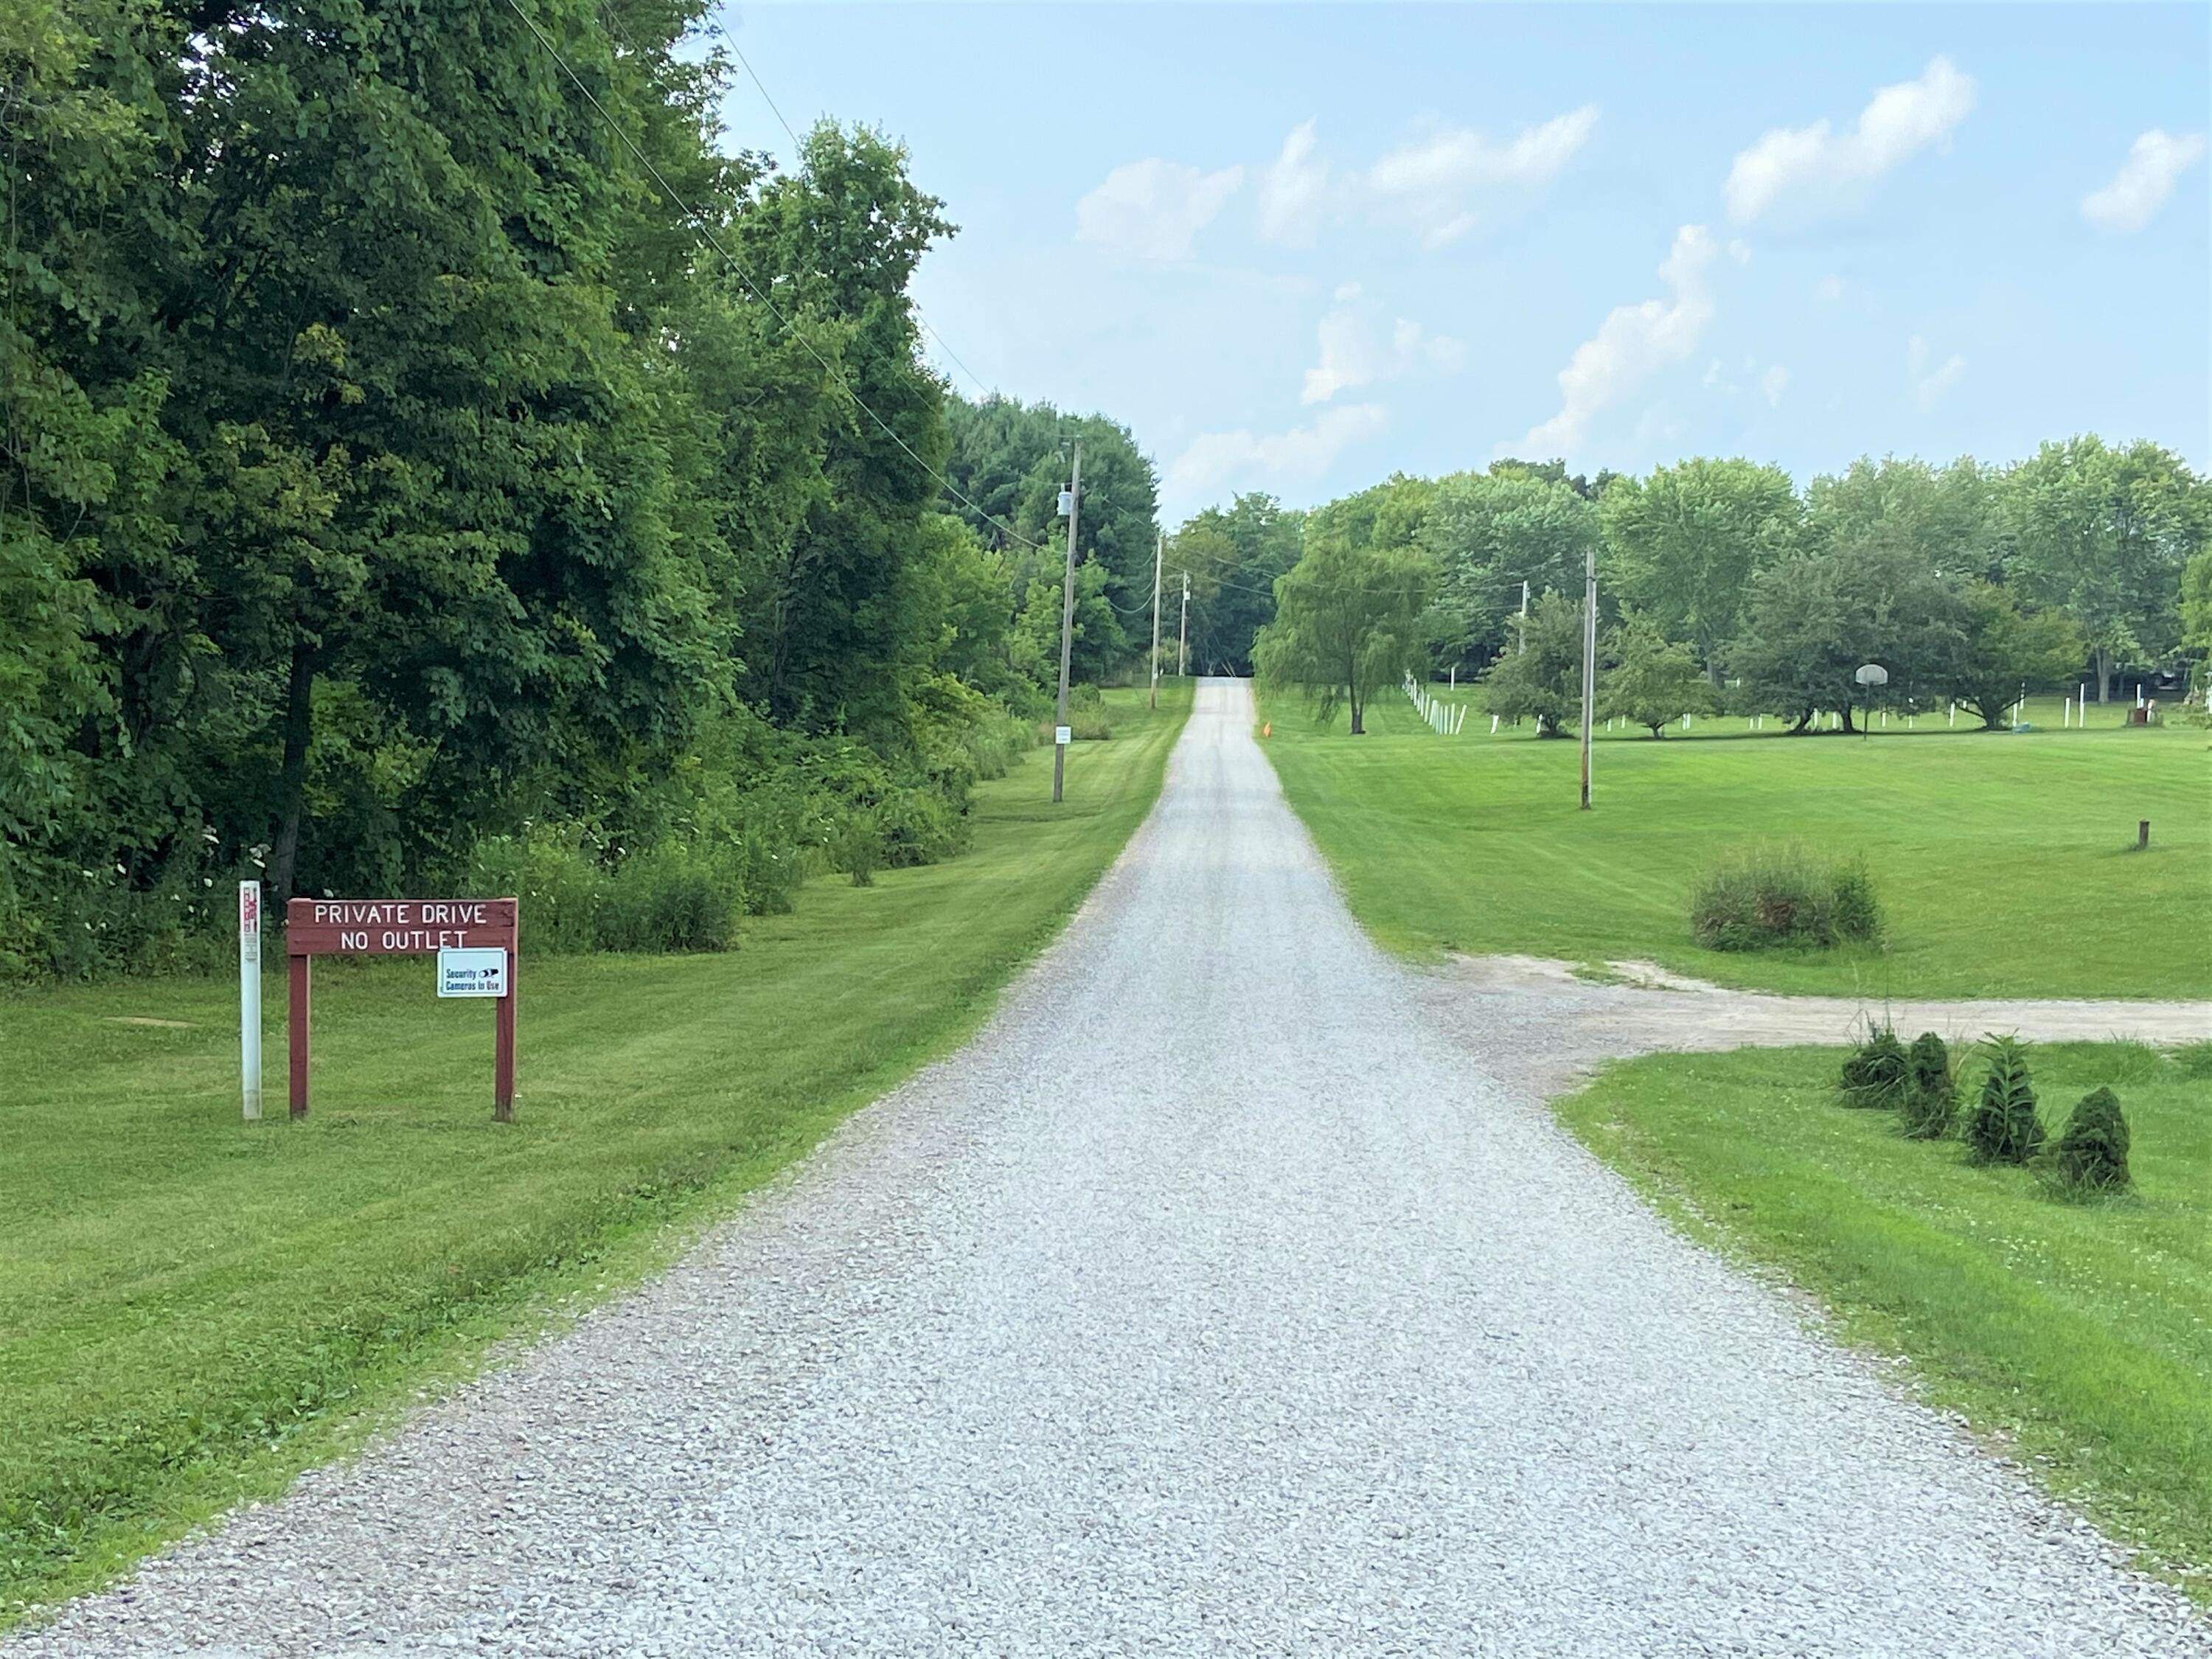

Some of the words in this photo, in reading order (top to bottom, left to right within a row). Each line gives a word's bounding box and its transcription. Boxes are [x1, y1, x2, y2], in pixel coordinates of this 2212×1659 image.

[315, 904, 410, 924] PRIVATE
[422, 904, 487, 924] DRIVE
[341, 931, 368, 950] NO
[382, 930, 468, 950] OUTLET
[446, 968, 476, 981] Security
[446, 981, 476, 990] Cameras
[487, 981, 499, 990] Use
